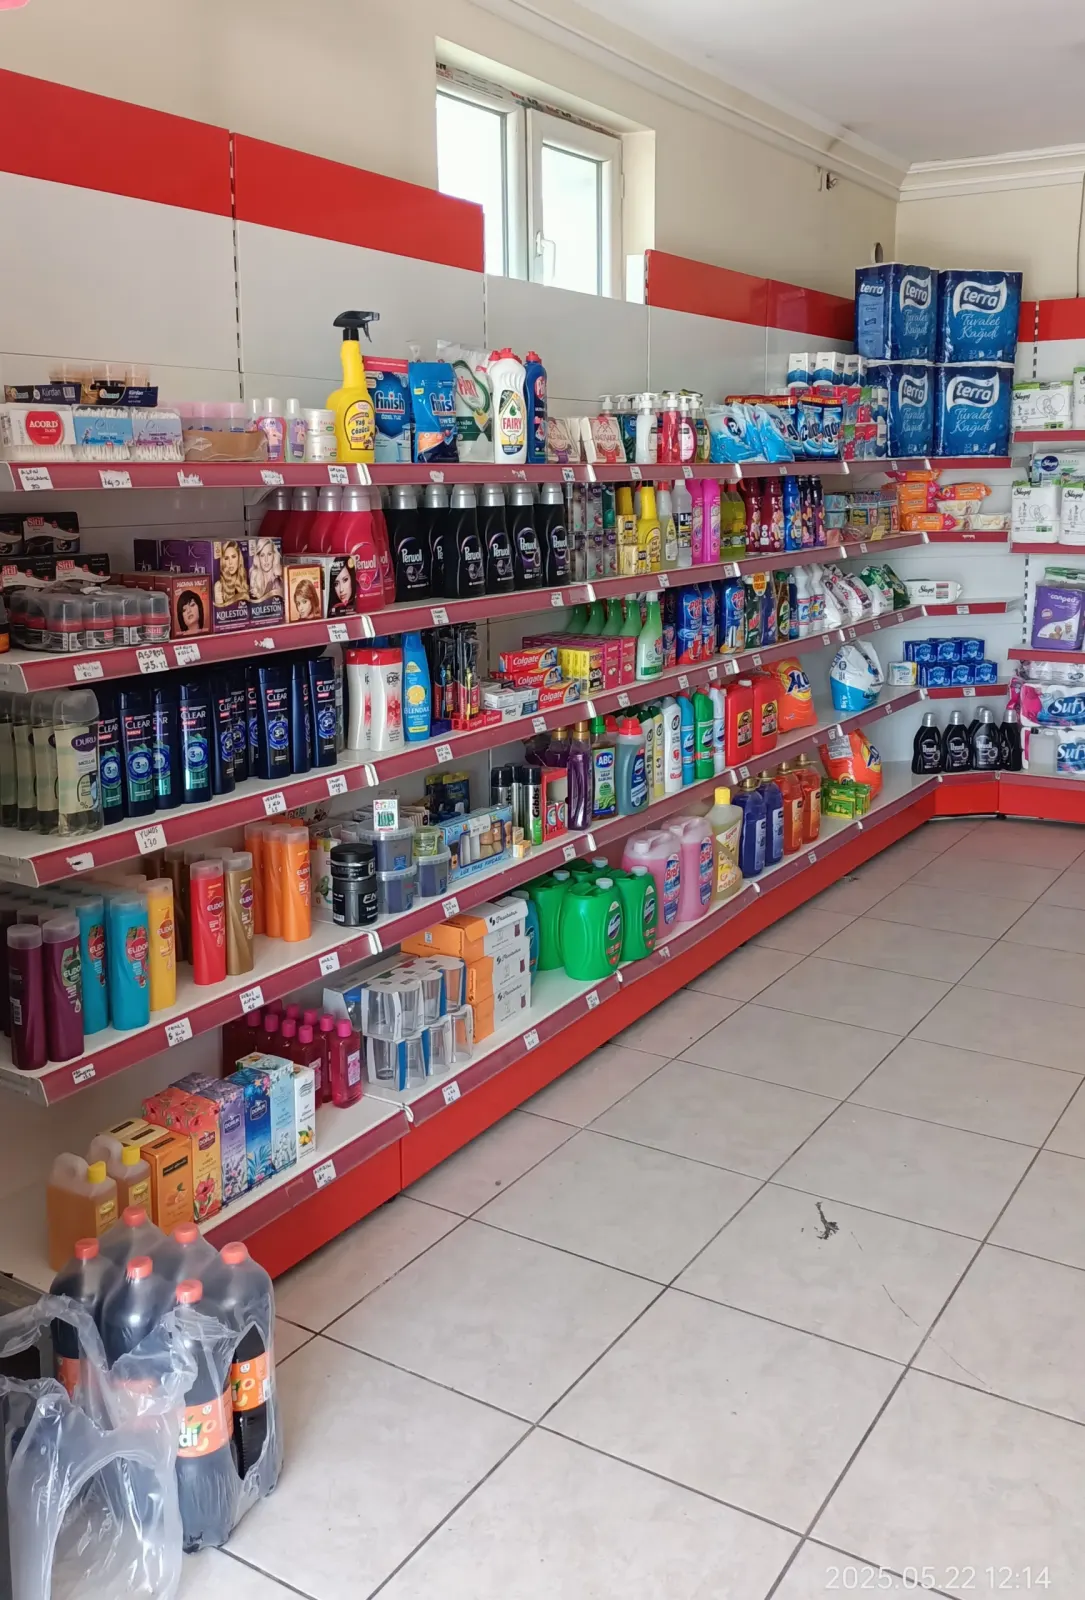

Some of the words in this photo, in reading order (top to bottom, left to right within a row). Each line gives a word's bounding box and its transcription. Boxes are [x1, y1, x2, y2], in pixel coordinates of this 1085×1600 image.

[860, 282, 884, 295] terra
[905, 282, 927, 302] terra
[963, 288, 1000, 307] terra
[903, 381, 924, 400] terra
[956, 382, 992, 401] terra
[375, 390, 405, 411] finish
[29, 419, 58, 429] ACORD
[502, 417, 522, 430] FAIRY
[27, 516, 44, 527] Sitil
[57, 560, 75, 571] Sitil
[217, 608, 248, 620] KOLESTON
[251, 604, 282, 615] KOLESTON
[513, 654, 540, 666] Colgate
[518, 673, 545, 686] Colgate
[317, 683, 335, 693] CLEAR
[266, 692, 287, 702] CLEAR
[540, 689, 563, 703] Colgate
[181, 711, 206, 721] CLEAR
[125, 719, 151, 730] CLEAR
[75, 737, 97, 748] DURU
[597, 753, 613, 765] ABC
[532, 787, 540, 818] Gibbs
